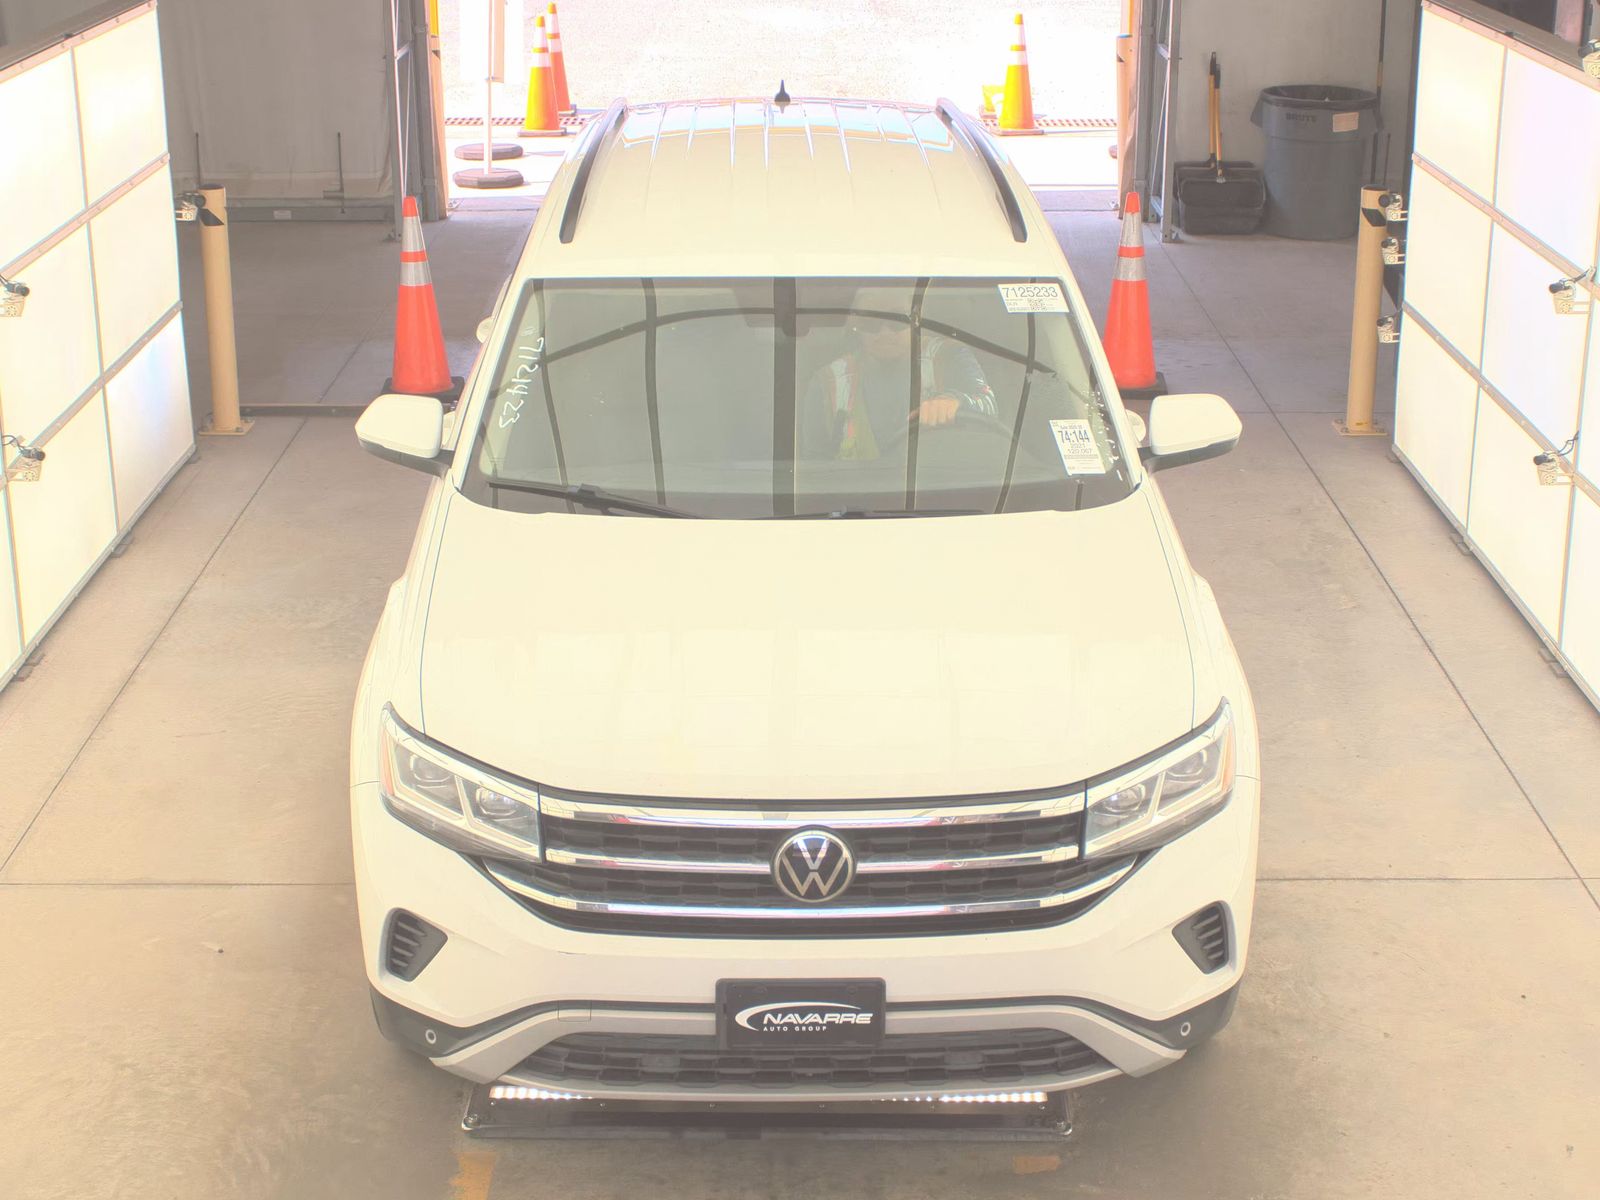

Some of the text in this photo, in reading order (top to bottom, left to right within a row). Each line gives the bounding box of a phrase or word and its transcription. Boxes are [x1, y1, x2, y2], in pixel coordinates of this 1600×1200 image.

[1001, 286, 1058, 298] 7125233
[1058, 430, 1090, 443] 74:144
[763, 1012, 874, 1025] NAVARRE
